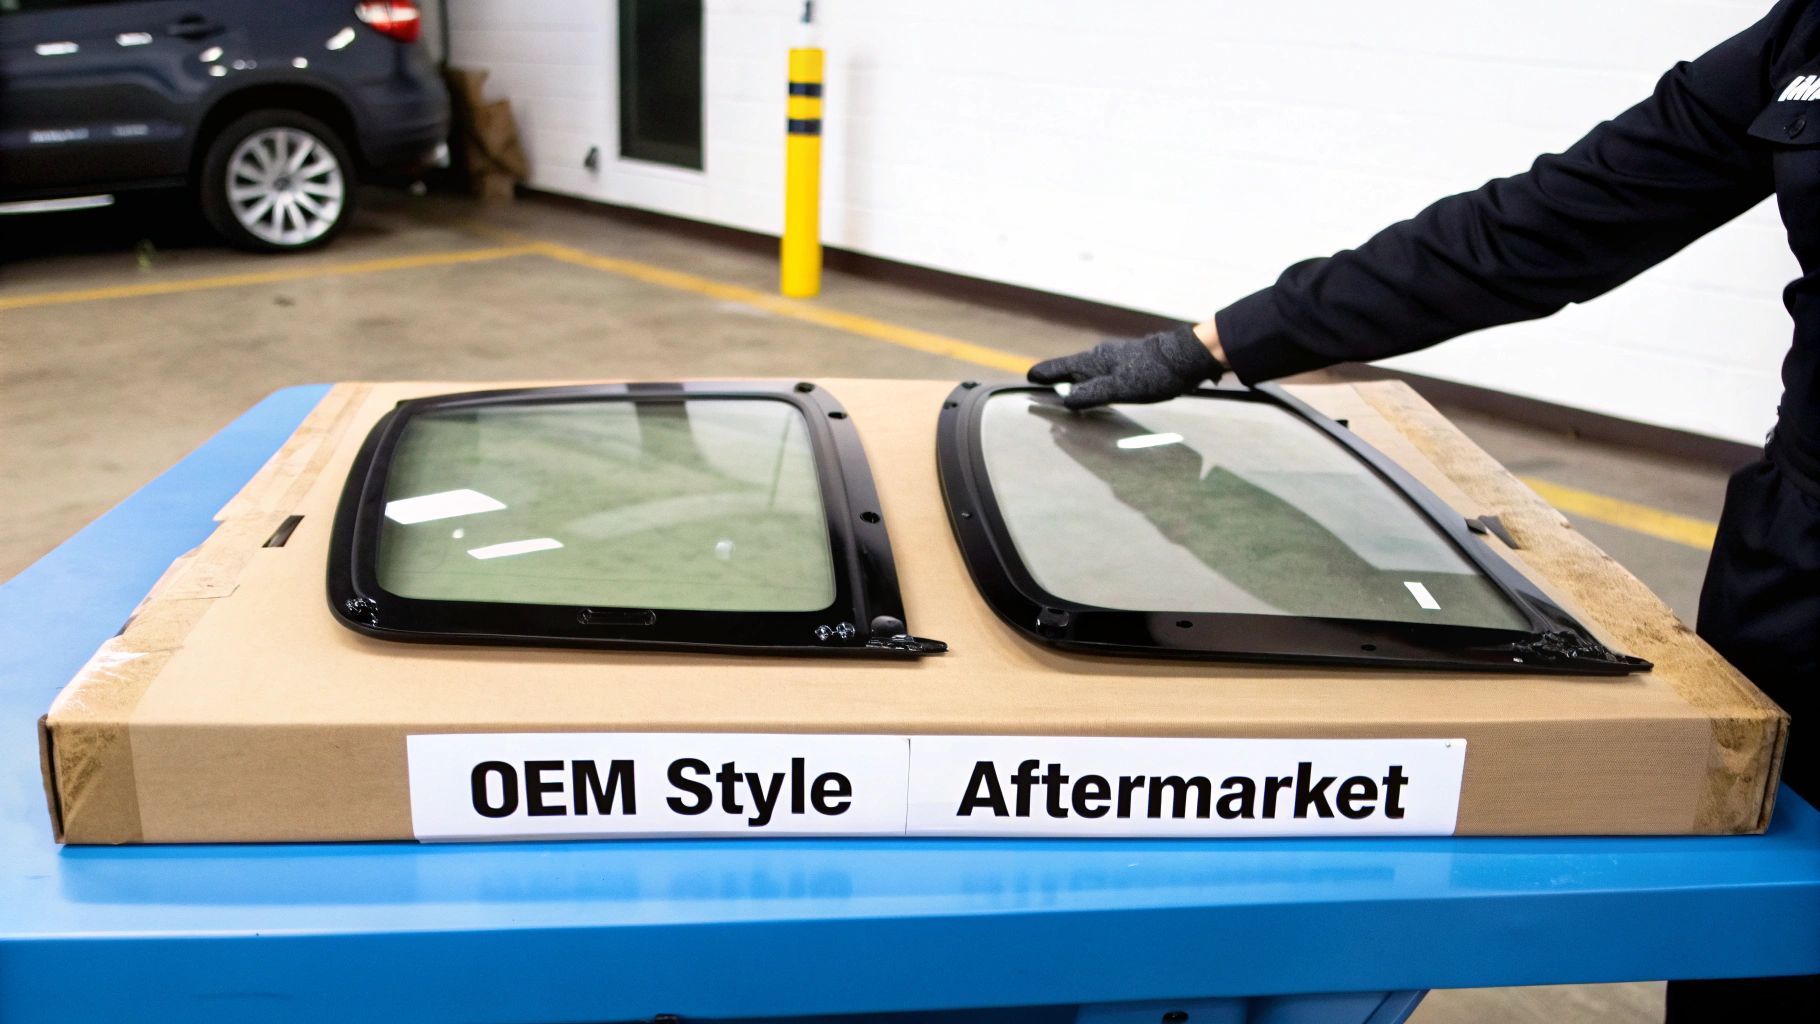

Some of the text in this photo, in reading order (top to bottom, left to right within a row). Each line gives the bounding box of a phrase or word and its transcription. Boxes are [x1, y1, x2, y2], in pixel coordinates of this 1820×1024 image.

[470, 757, 852, 828] OEM Style
[956, 759, 1409, 820] Aftermarket
